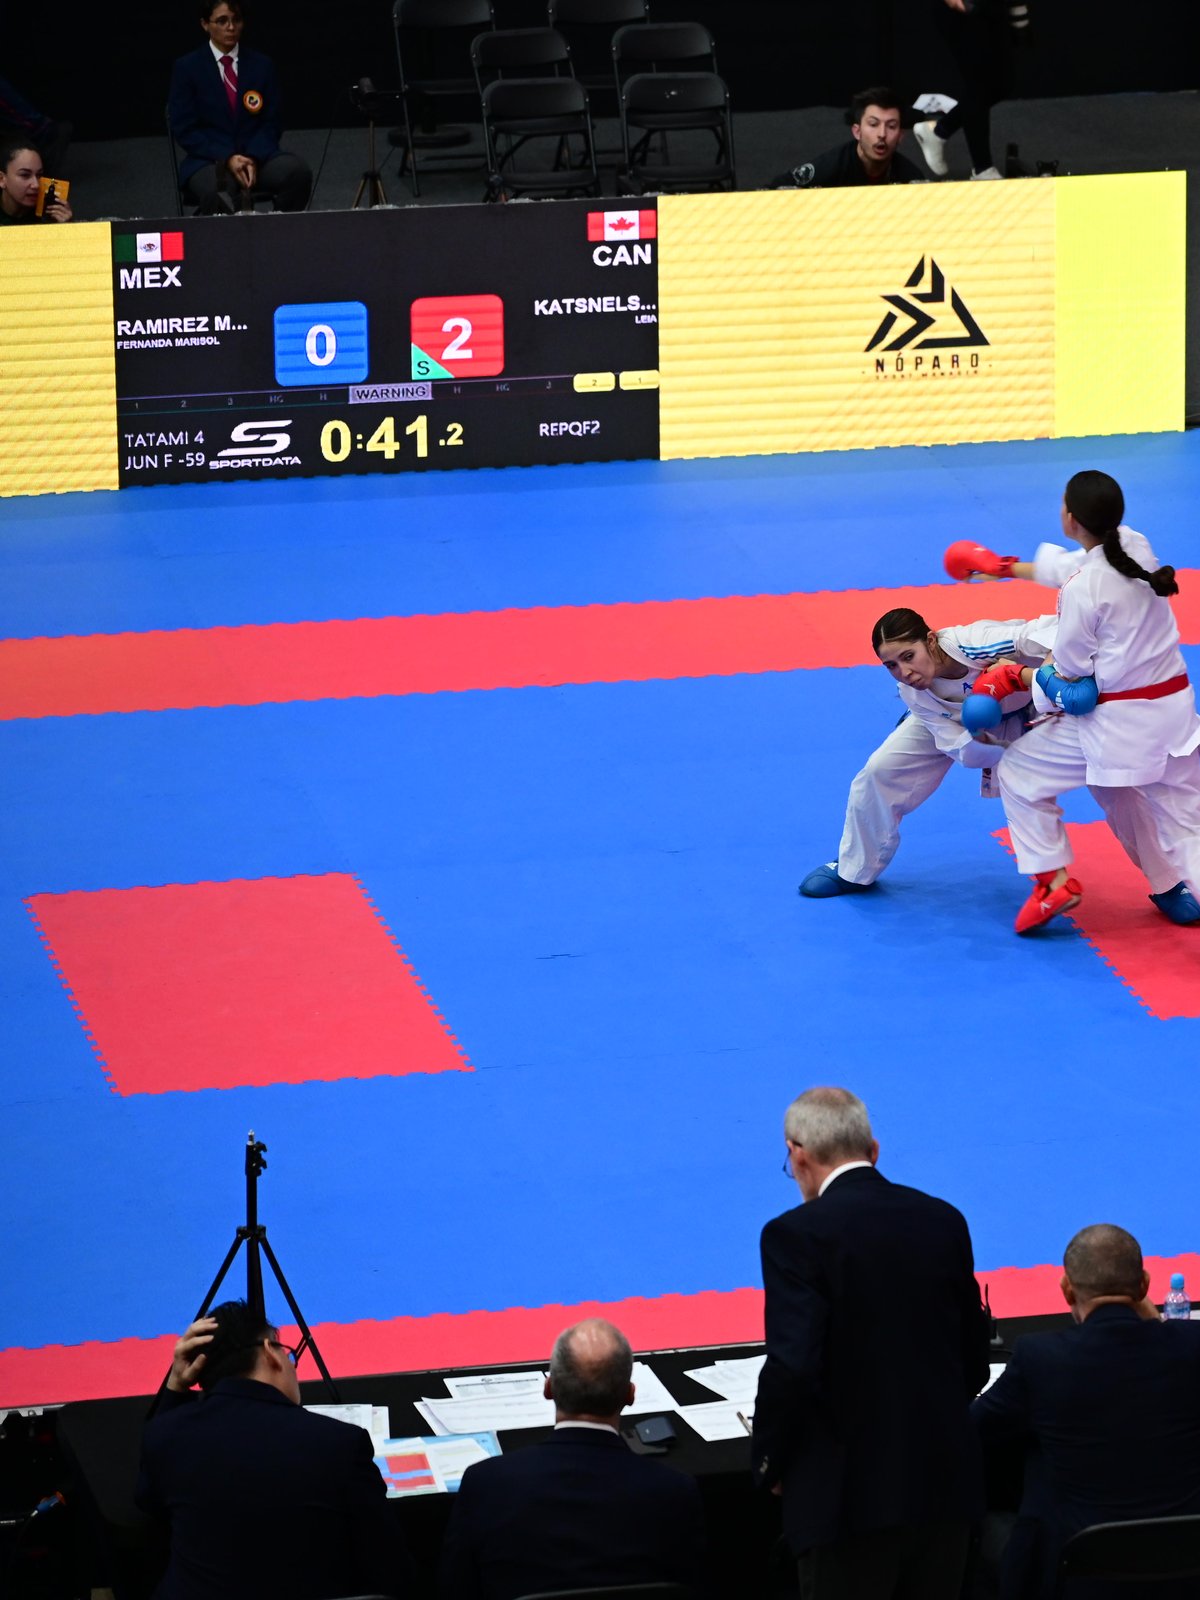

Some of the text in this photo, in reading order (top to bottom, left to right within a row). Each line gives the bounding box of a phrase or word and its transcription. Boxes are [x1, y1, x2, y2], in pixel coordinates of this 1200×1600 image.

[592, 243, 652, 267] CAN
[120, 266, 182, 289] MEX
[117, 317, 209, 336] RAMIREZ
[635, 315, 657, 324] LEIA
[117, 336, 220, 350] FERNANDA MARISOL
[305, 324, 337, 366] 0
[441, 317, 473, 360] 2
[417, 360, 430, 376] S
[876, 352, 979, 373] NÓPARO
[356, 385, 426, 400] WARNING
[180, 400, 187, 408] 2
[539, 420, 600, 437] REPQF2
[125, 430, 204, 448] TATAMI 4
[125, 452, 205, 470] JUN F -59
[209, 456, 302, 470] SPORTDATA
